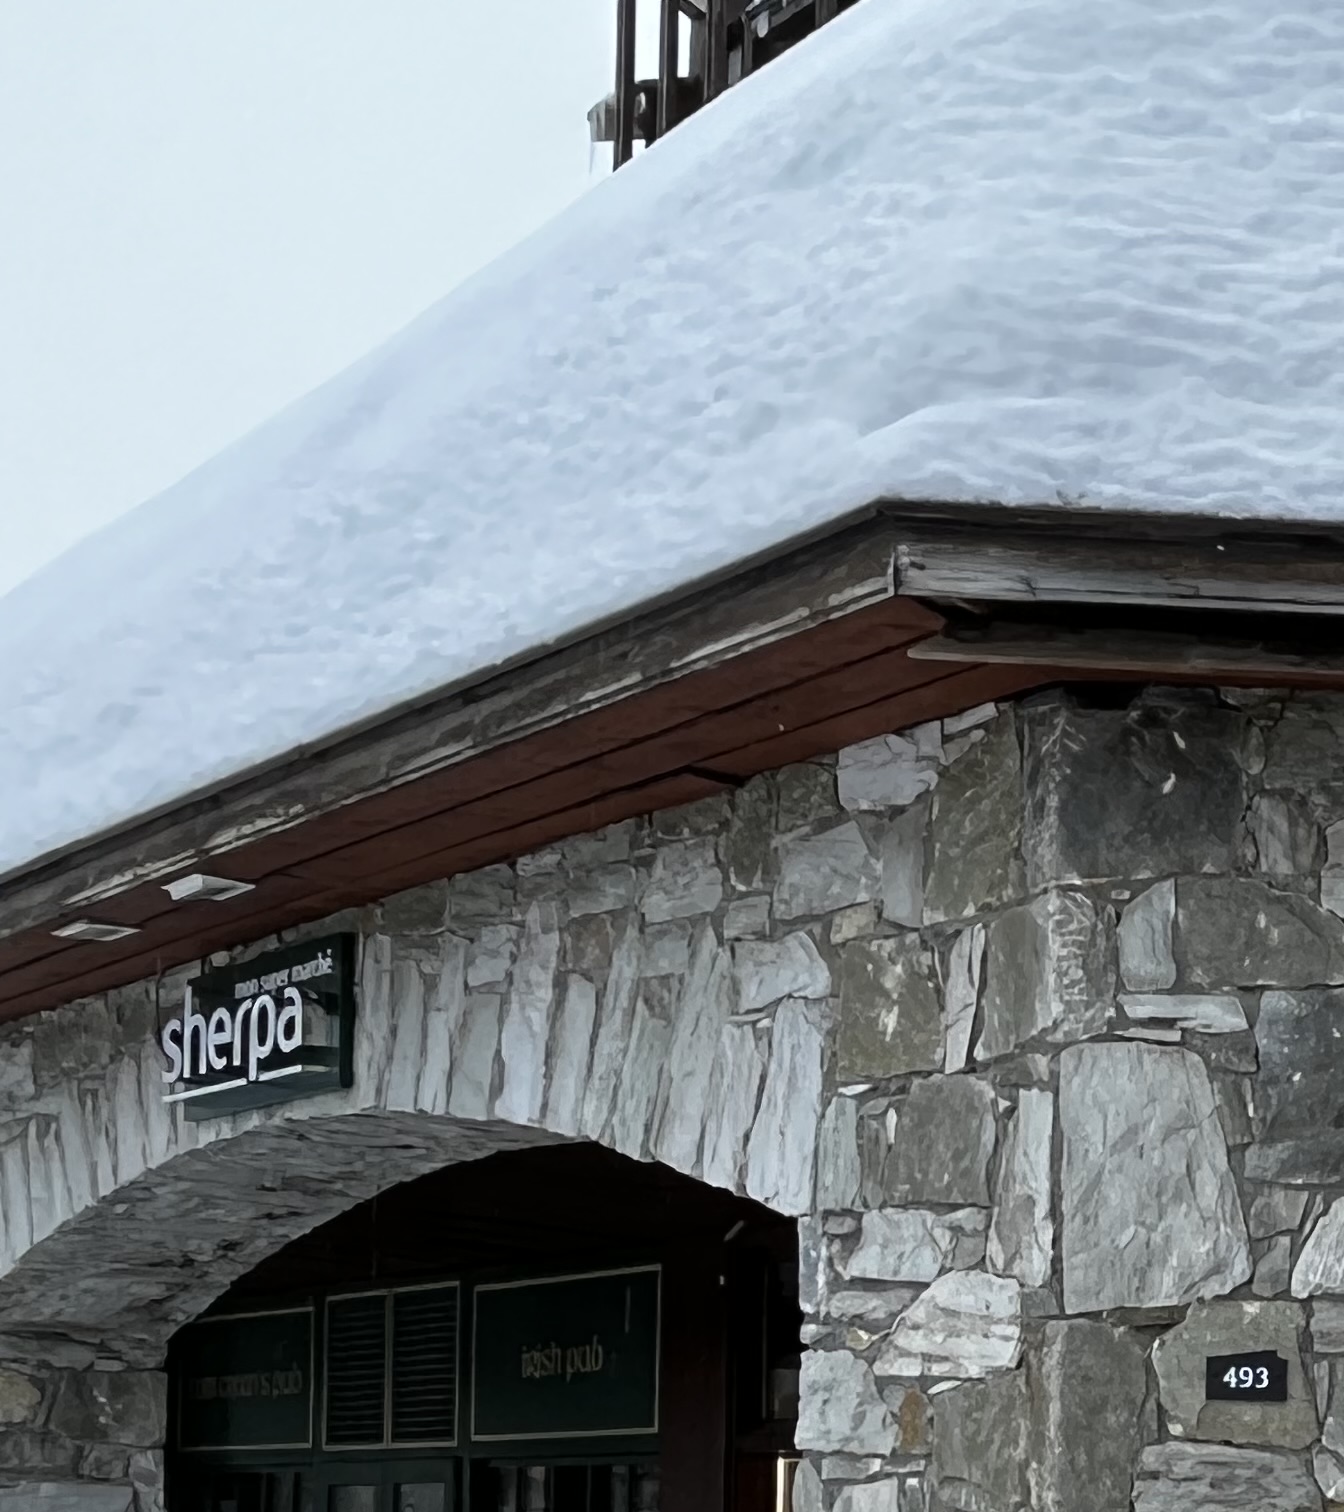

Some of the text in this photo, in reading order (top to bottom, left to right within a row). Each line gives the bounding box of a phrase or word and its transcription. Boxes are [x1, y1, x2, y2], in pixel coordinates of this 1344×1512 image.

[161, 985, 303, 1084] sherpa
[565, 1333, 604, 1384] pub
[1222, 1366, 1269, 1389] 493
